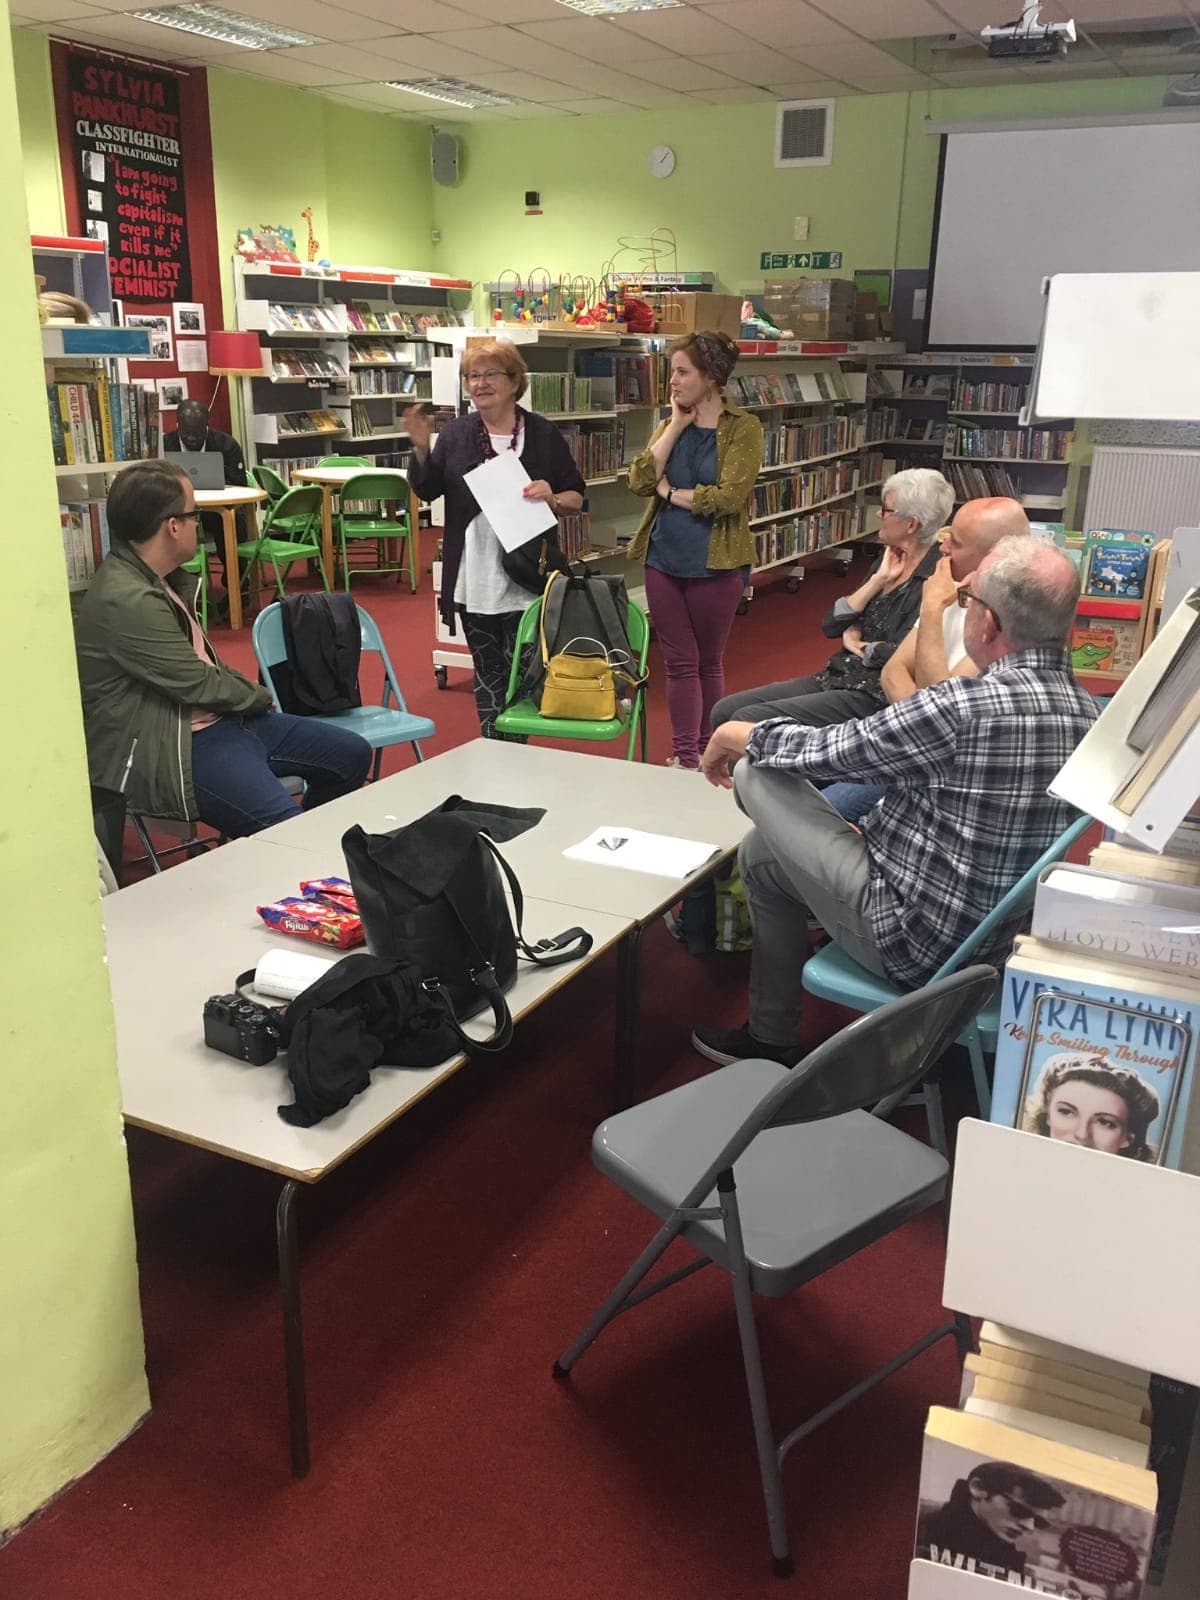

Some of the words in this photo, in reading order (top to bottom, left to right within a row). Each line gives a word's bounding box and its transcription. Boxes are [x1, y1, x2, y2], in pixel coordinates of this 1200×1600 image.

[84, 66, 165, 107] SYLVIA
[72, 91, 178, 138] PANKHURST
[76, 119, 180, 154] CLASSFIGHTER
[95, 141, 179, 167] INTERNATIONALIST
[122, 166, 139, 179] am
[142, 171, 178, 192] going
[115, 180, 129, 196] to
[131, 183, 168, 206] fight
[118, 204, 183, 226] capitalism
[120, 222, 151, 238] even
[154, 225, 165, 240] if
[171, 228, 181, 243] it
[121, 236, 150, 255] kills
[108, 256, 180, 280] OCIALIST
[112, 277, 178, 298] EMINIST
[1048, 928, 1131, 953] LLOYD
[1105, 996, 1193, 1050] LYNN
[1047, 1032, 1111, 1061] Smiling
